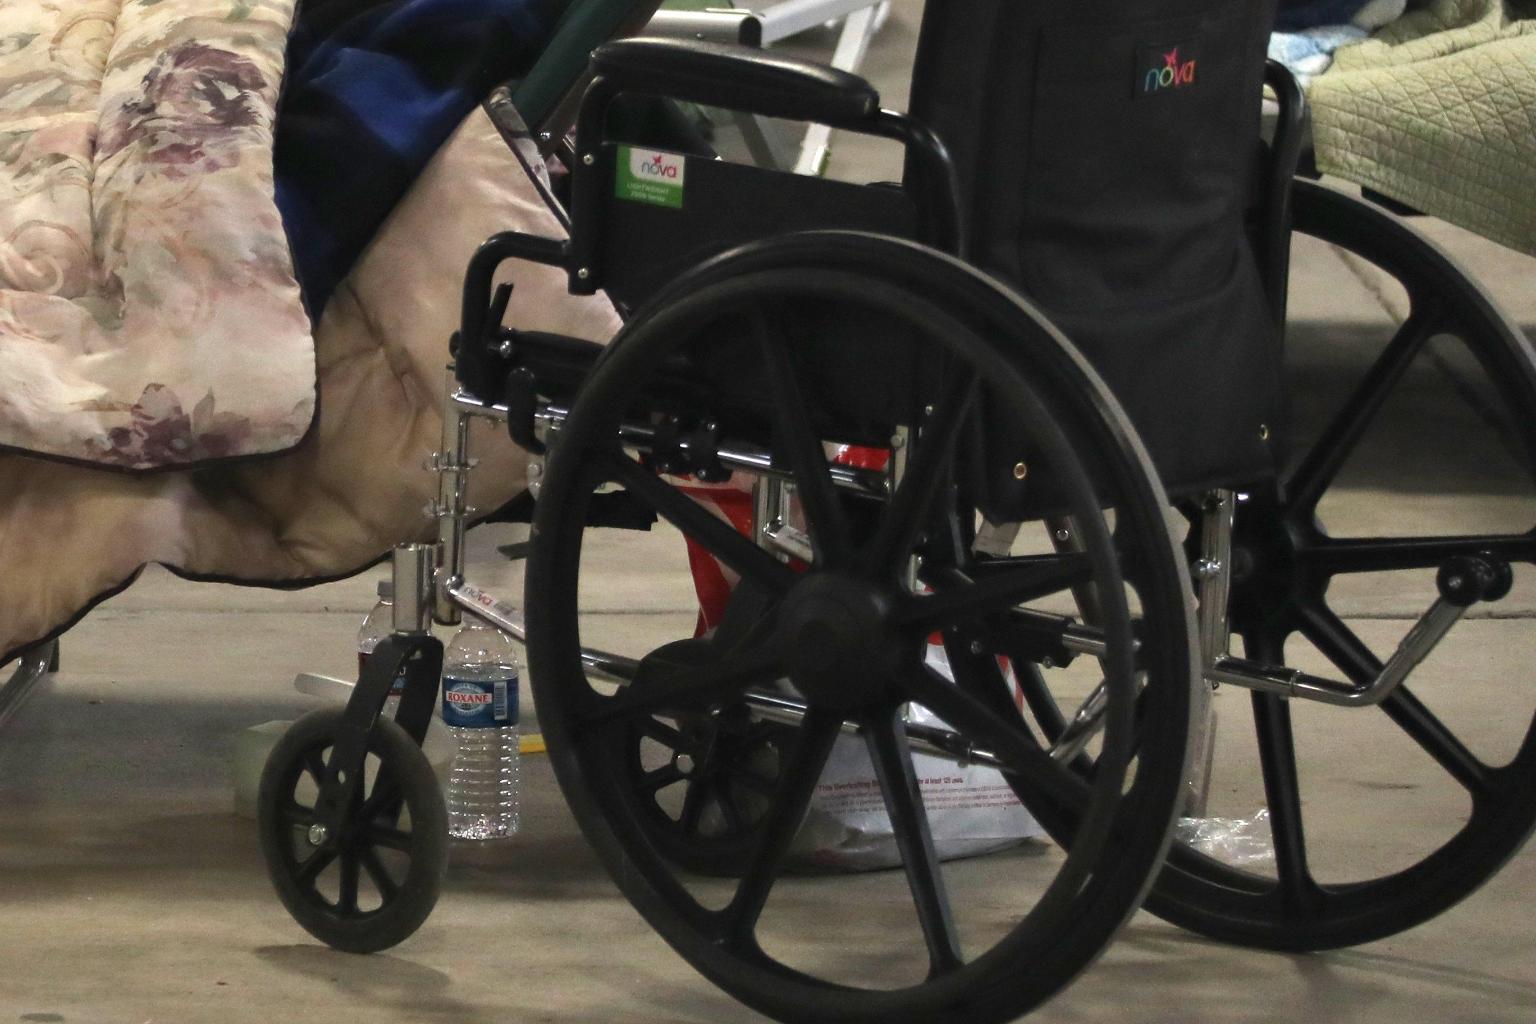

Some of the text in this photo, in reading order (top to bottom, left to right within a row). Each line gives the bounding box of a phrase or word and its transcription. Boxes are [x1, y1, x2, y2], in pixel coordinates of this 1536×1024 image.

[1144, 61, 1196, 92] nova
[641, 162, 677, 178] nova
[448, 692, 489, 704] ROXANE
